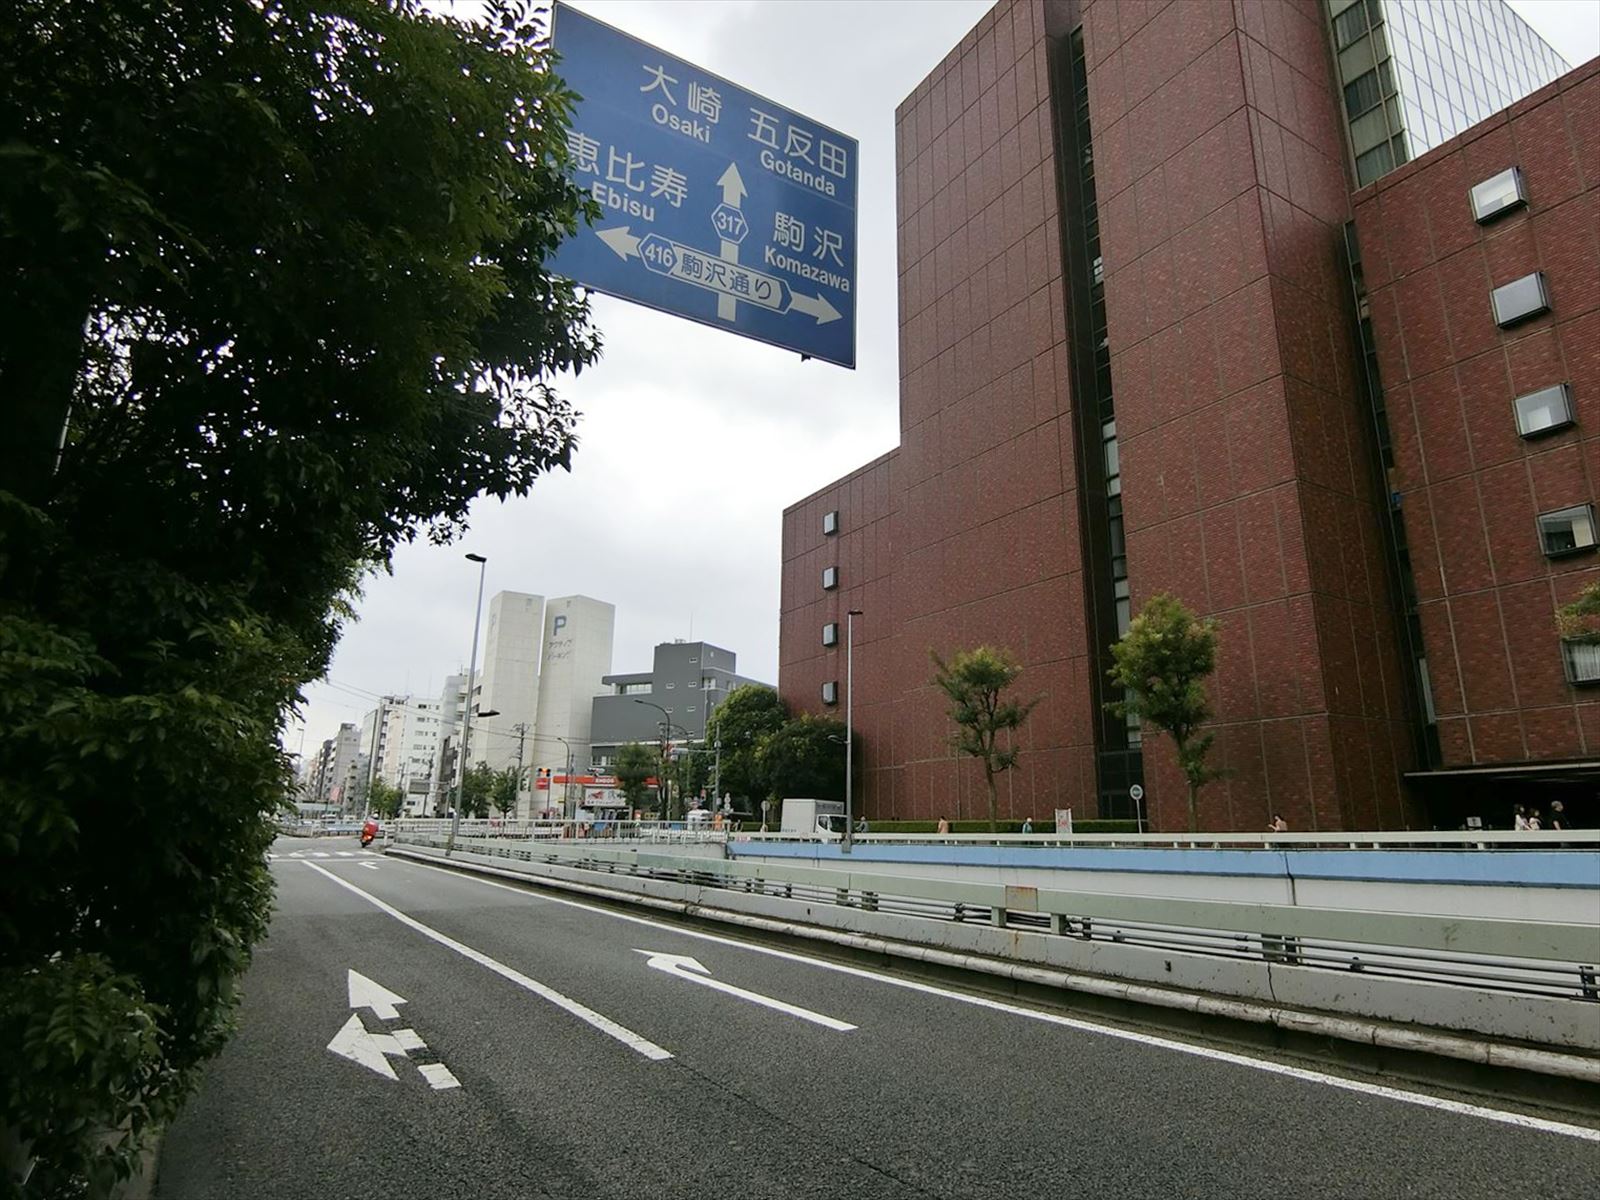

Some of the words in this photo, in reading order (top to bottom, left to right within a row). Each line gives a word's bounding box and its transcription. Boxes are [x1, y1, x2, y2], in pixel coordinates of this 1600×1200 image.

[640, 64, 723, 125] 大崎
[652, 103, 710, 143] Osaki
[747, 107, 847, 179] 五反田
[565, 129, 689, 208] 恵比寿
[760, 149, 836, 197] Gotanda
[592, 181, 655, 222] Ebisu
[717, 212, 743, 236] 317
[645, 243, 673, 268] 416
[773, 211, 845, 268] 駒沢
[680, 253, 772, 300] 駒沢通り
[764, 245, 850, 293] Komazawa
[553, 615, 567, 637] P
